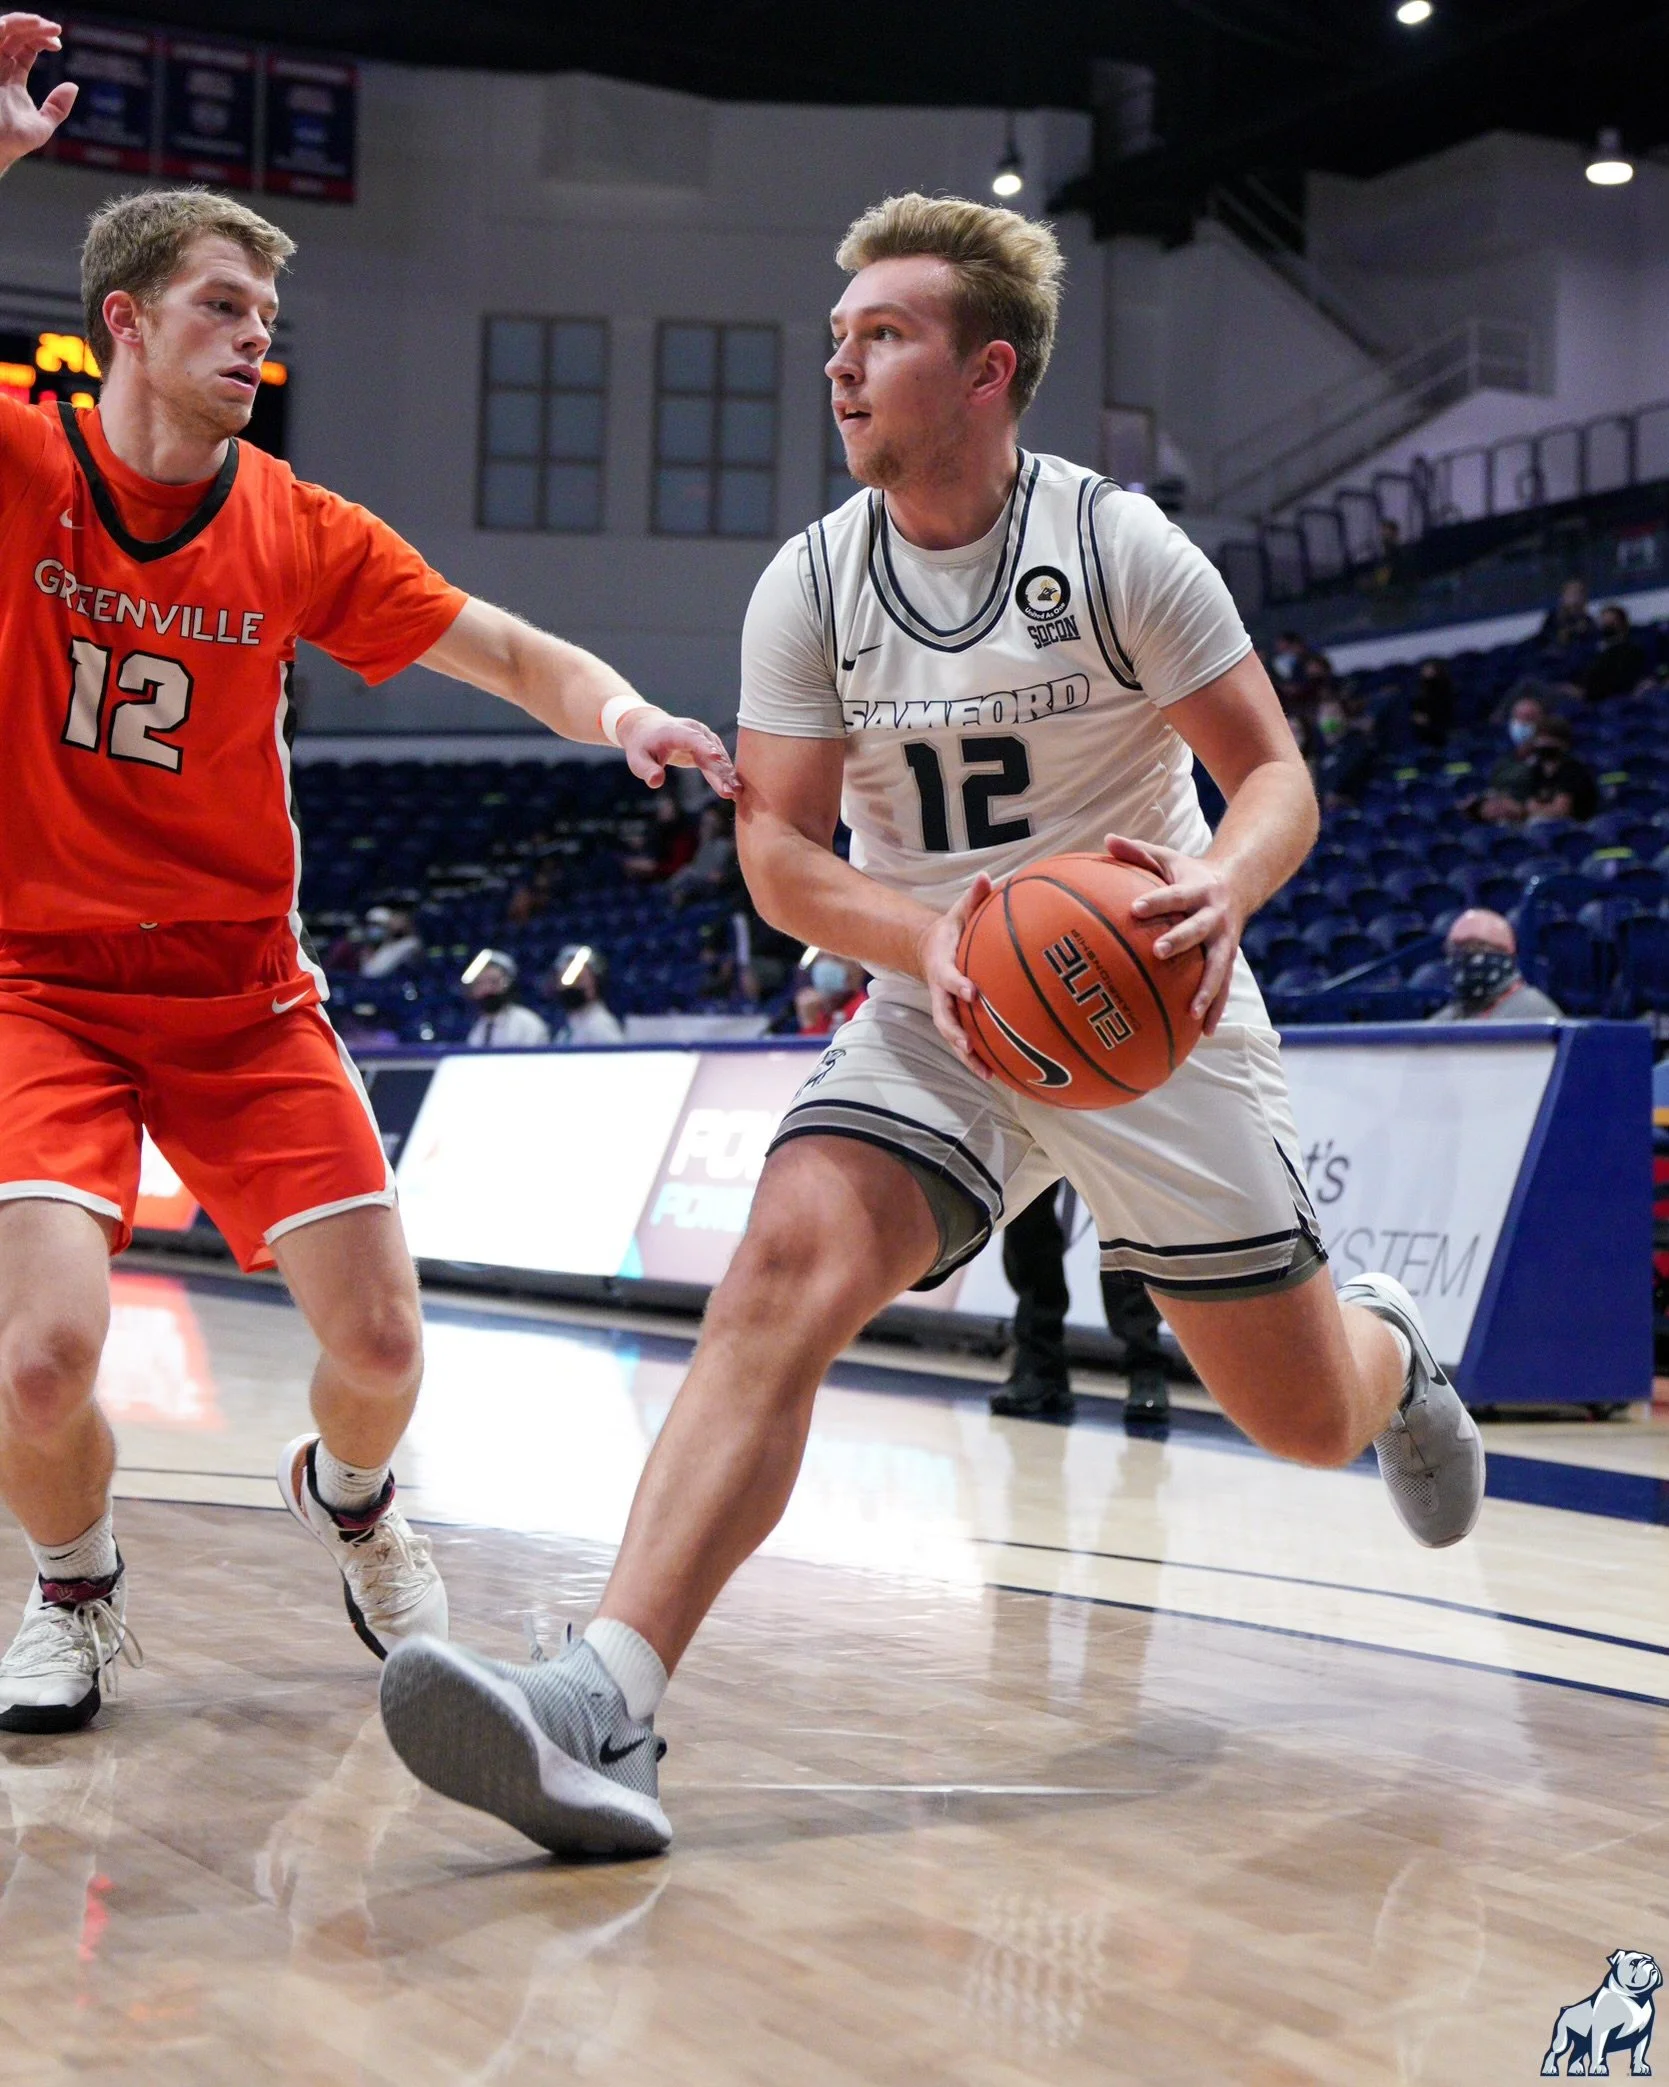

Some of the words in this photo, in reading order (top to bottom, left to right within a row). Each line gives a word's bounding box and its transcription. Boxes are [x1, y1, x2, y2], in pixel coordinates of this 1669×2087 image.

[33, 558, 265, 646] GREENVILLE
[1027, 615, 1081, 649] SOCON
[60, 636, 195, 776] 12
[842, 673, 1090, 730] SAMFORD
[902, 731, 1035, 853] 12
[1043, 934, 1134, 1050] ELITE
